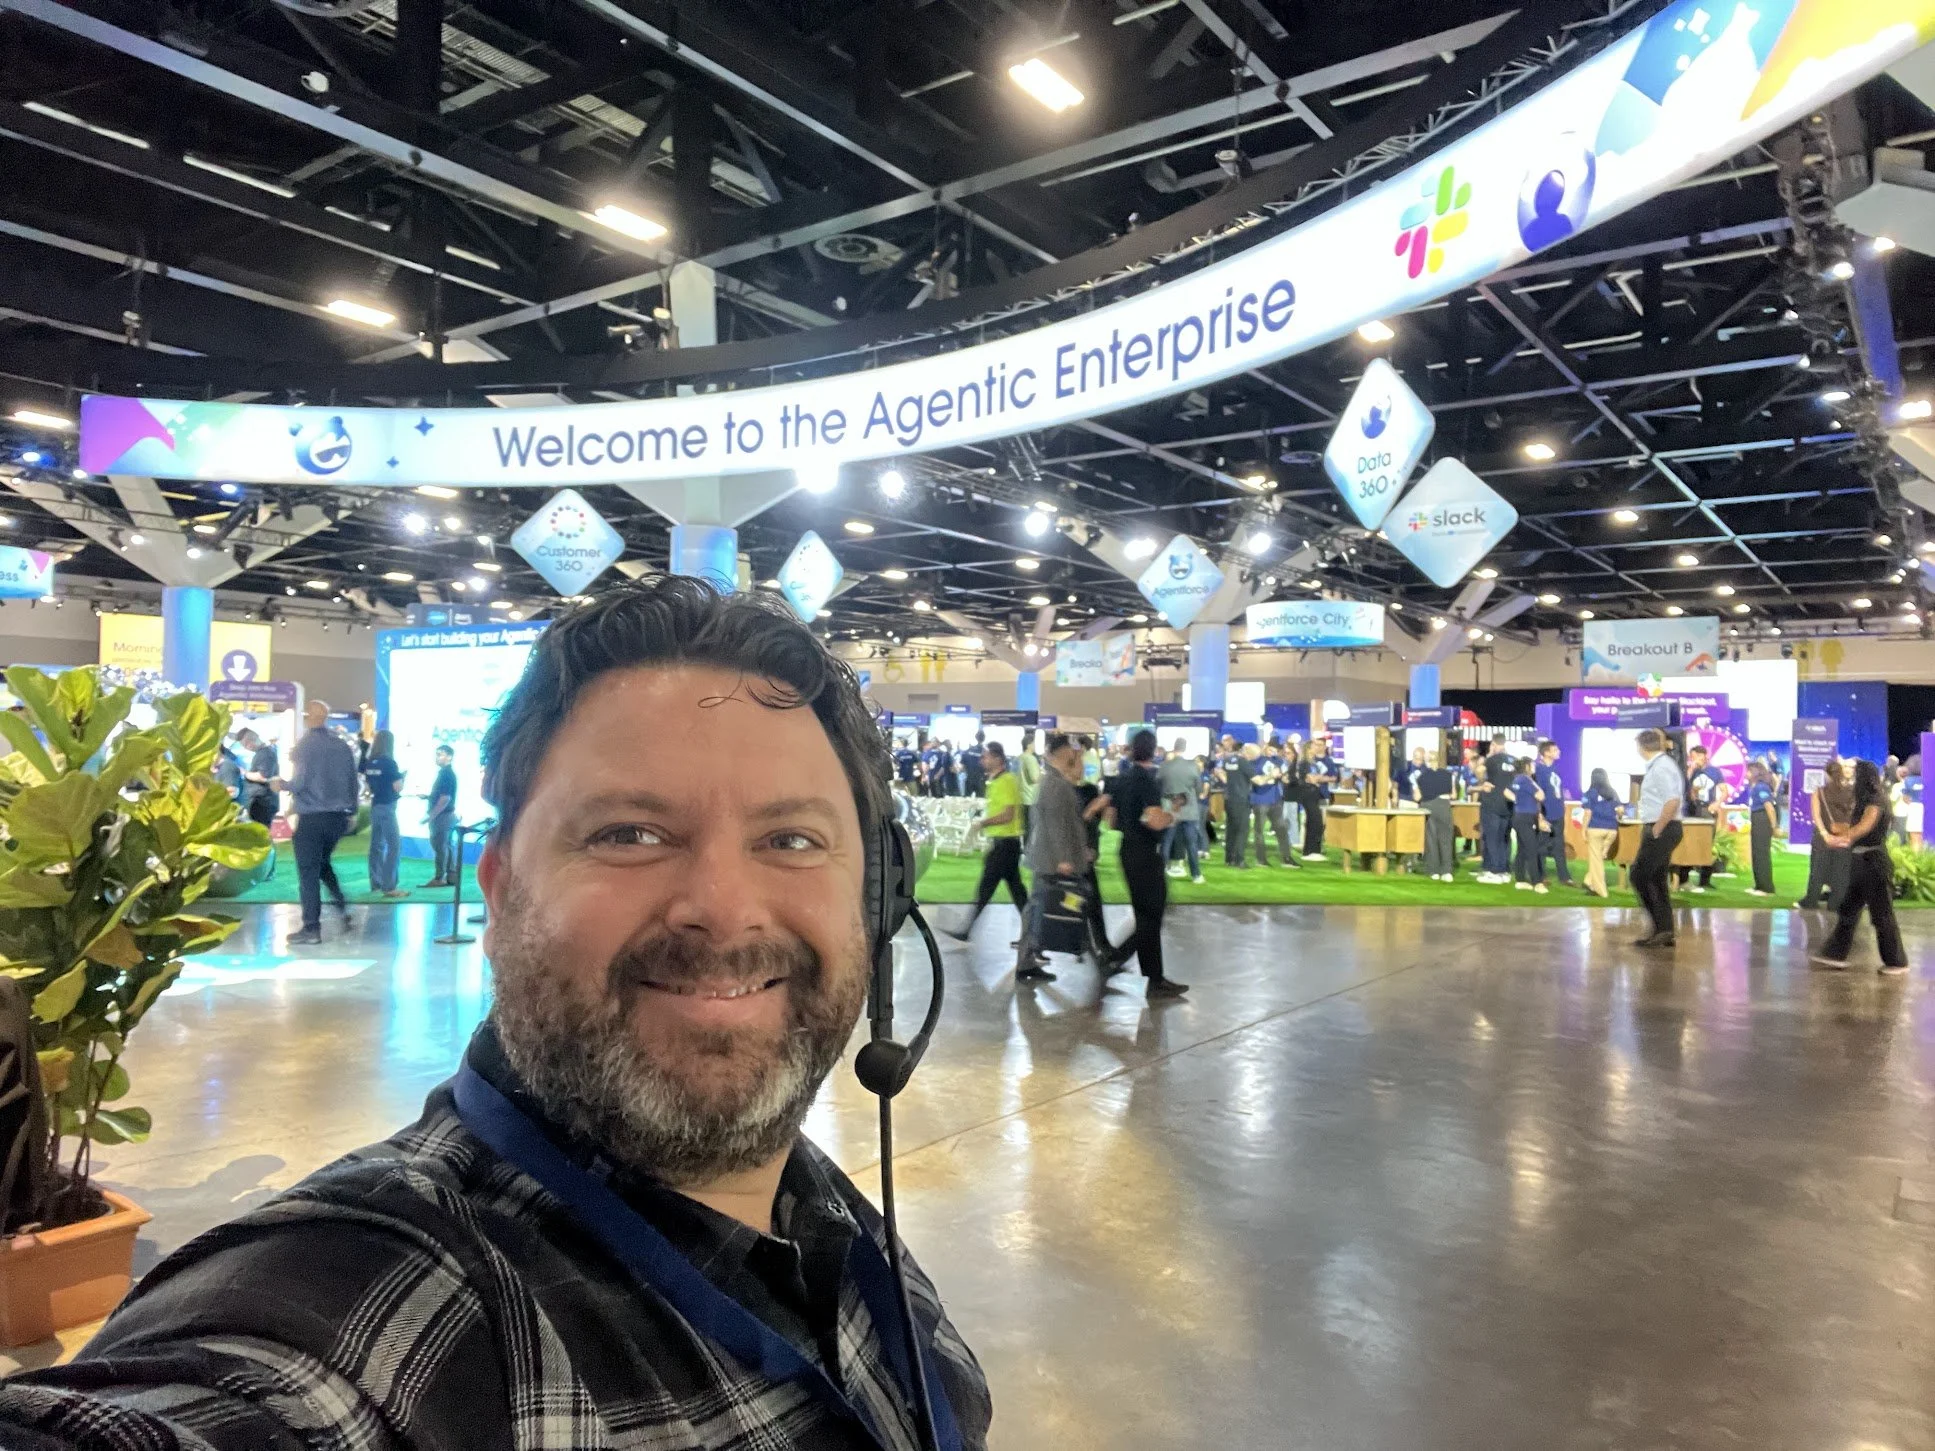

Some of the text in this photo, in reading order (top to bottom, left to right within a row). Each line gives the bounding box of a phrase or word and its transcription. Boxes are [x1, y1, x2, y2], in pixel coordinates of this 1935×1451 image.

[493, 278, 1297, 467] Welcome to the Agentic Enterprise
[1358, 451, 1391, 474] Data
[1359, 475, 1389, 499] 360
[1432, 507, 1487, 527] slack
[536, 545, 602, 559] Customer
[555, 560, 584, 573] 360
[1323, 612, 1350, 628] City
[1607, 642, 1693, 656] Breakout B
